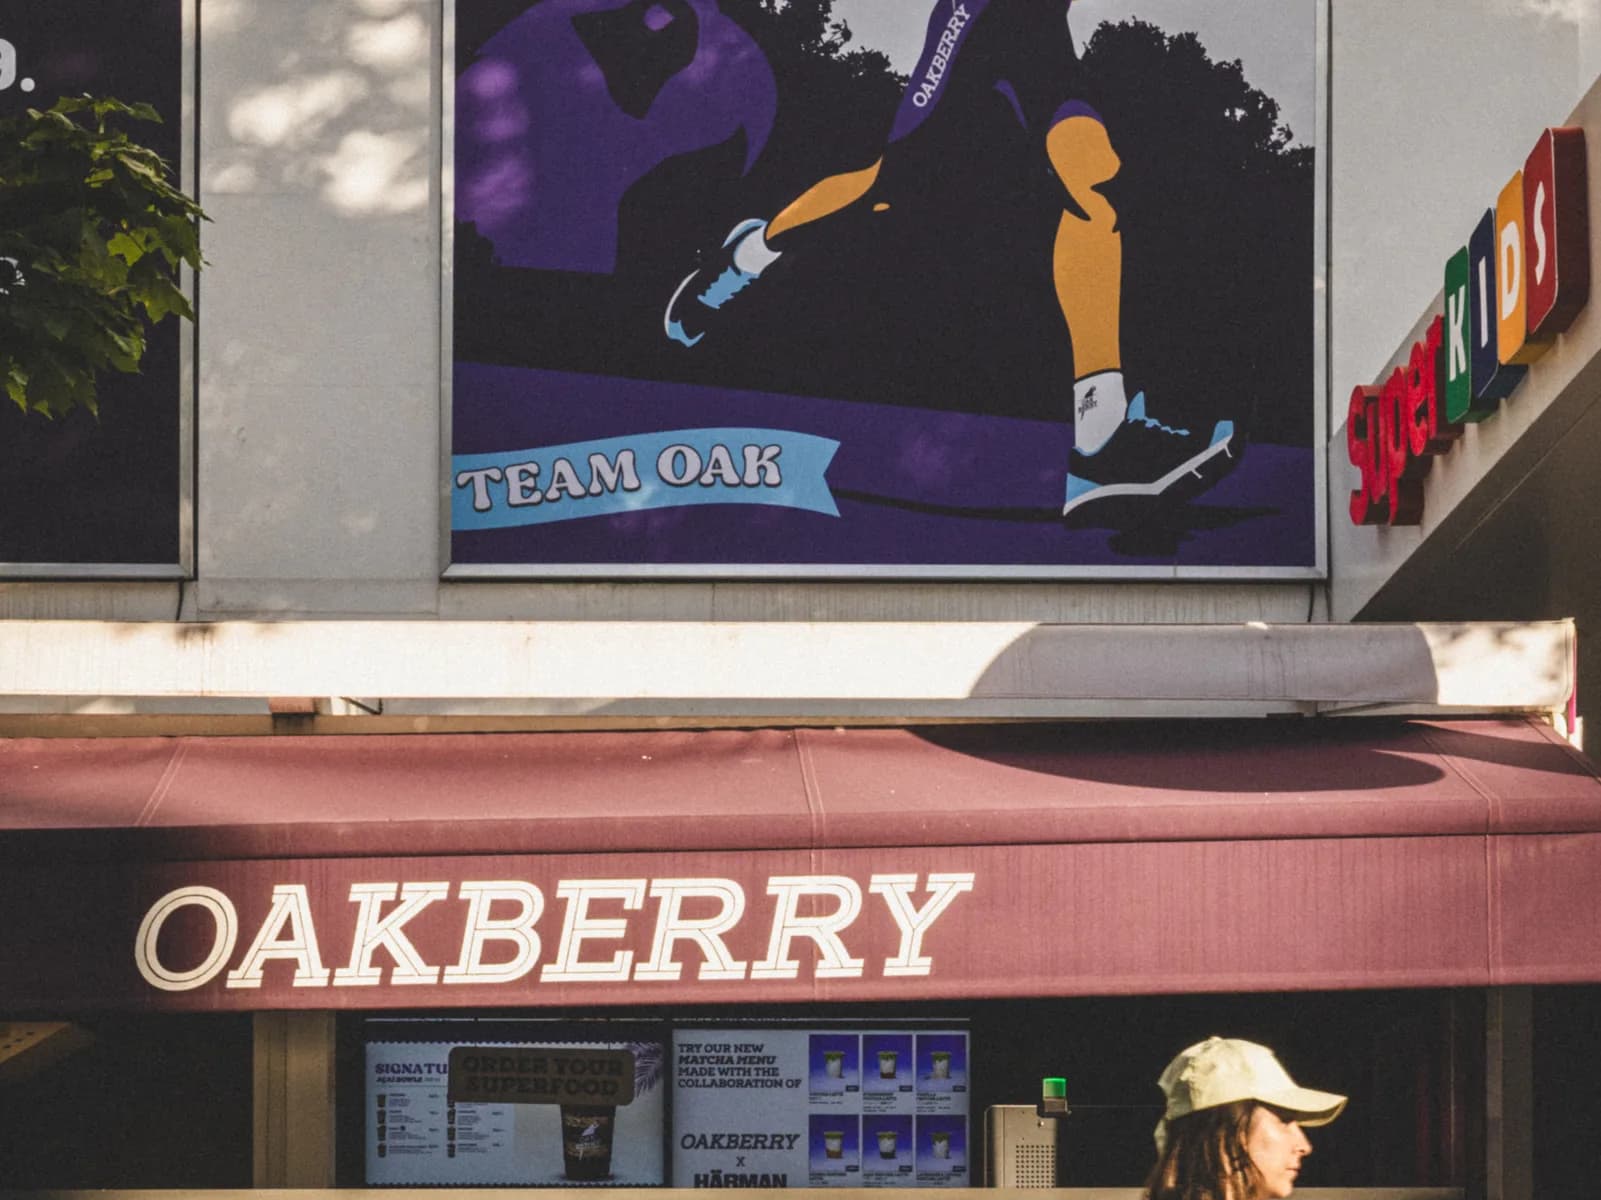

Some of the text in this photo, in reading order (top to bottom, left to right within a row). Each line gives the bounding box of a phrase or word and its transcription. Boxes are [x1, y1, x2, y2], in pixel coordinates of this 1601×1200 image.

[913, 3, 971, 108] OAKBERRY
[456, 443, 783, 513] TEAM OAK
[134, 872, 975, 992] OAKBERRY
[678, 1043, 764, 1053] TRY OUR NEW
[463, 1055, 624, 1077] ORDER YOUR
[678, 1055, 777, 1065] MATCHA MENU
[678, 1067, 780, 1077] MADE WITH THE
[465, 1075, 620, 1096] SUPERFOOD
[678, 1079, 802, 1088] COLLABORATION OF
[681, 1133, 801, 1150] OAKBERRY
